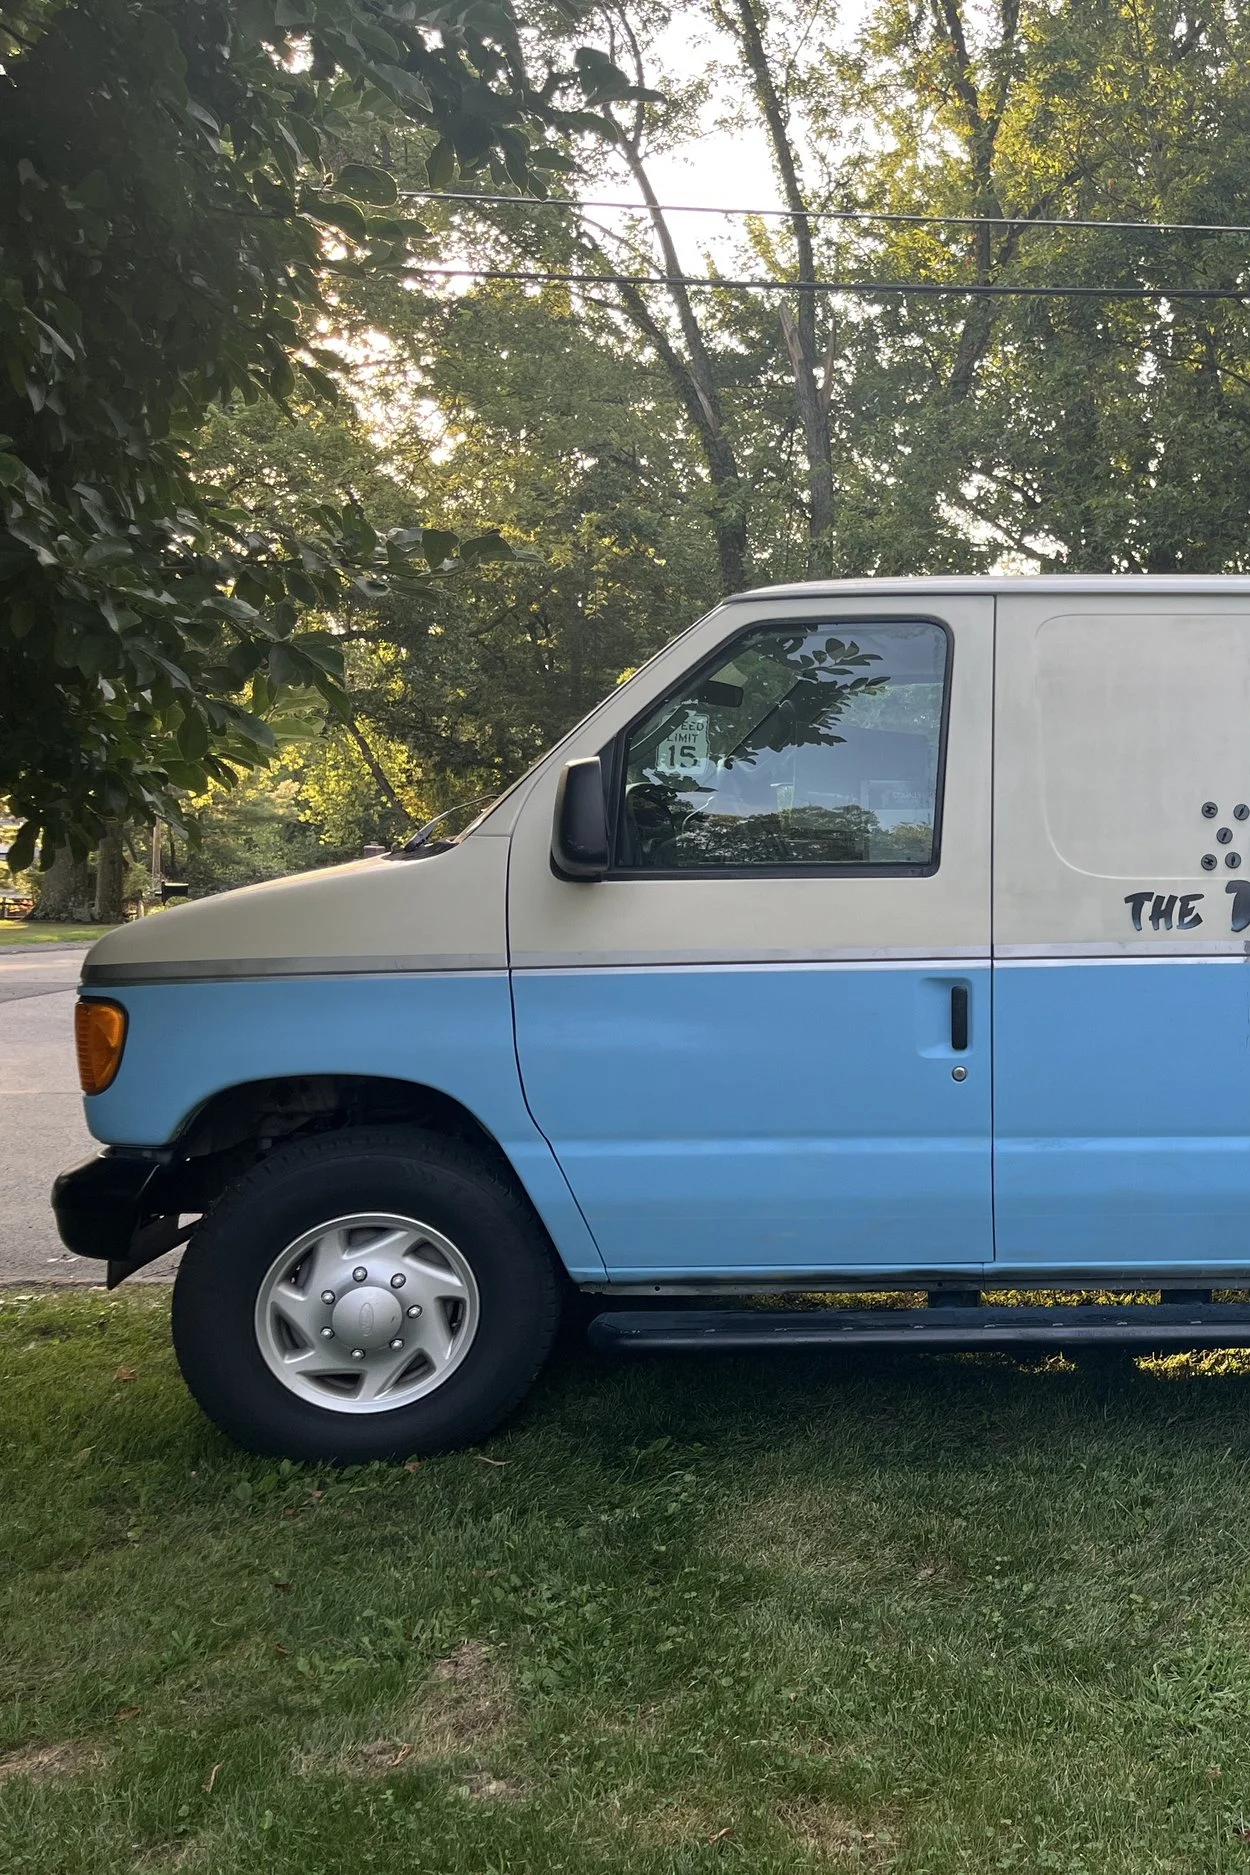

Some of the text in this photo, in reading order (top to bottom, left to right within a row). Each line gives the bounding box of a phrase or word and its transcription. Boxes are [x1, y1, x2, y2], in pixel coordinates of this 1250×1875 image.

[679, 722, 704, 731] EED
[668, 744, 699, 768] 15
[1125, 892, 1204, 931] THE
